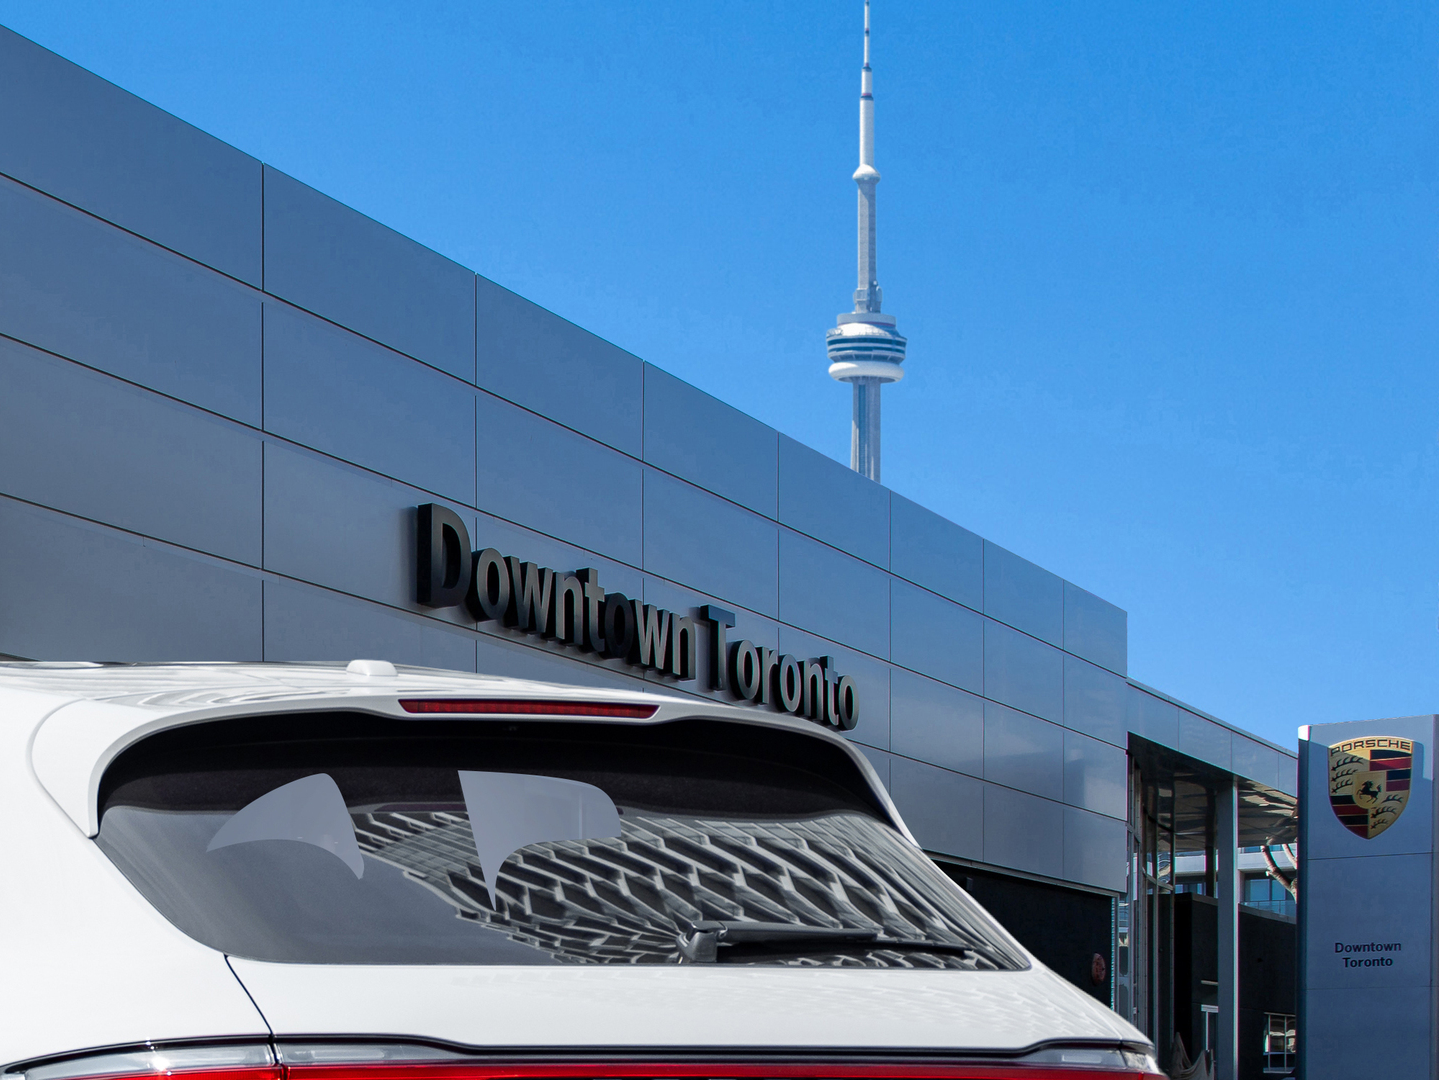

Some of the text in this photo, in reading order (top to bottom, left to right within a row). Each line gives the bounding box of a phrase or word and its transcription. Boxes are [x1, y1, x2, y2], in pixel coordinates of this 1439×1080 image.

[416, 503, 860, 731] Downtown Toronto
[1330, 738, 1412, 757] PORSCHE
[1334, 942, 1402, 953] Downtown
[1342, 956, 1393, 968] Toronto
